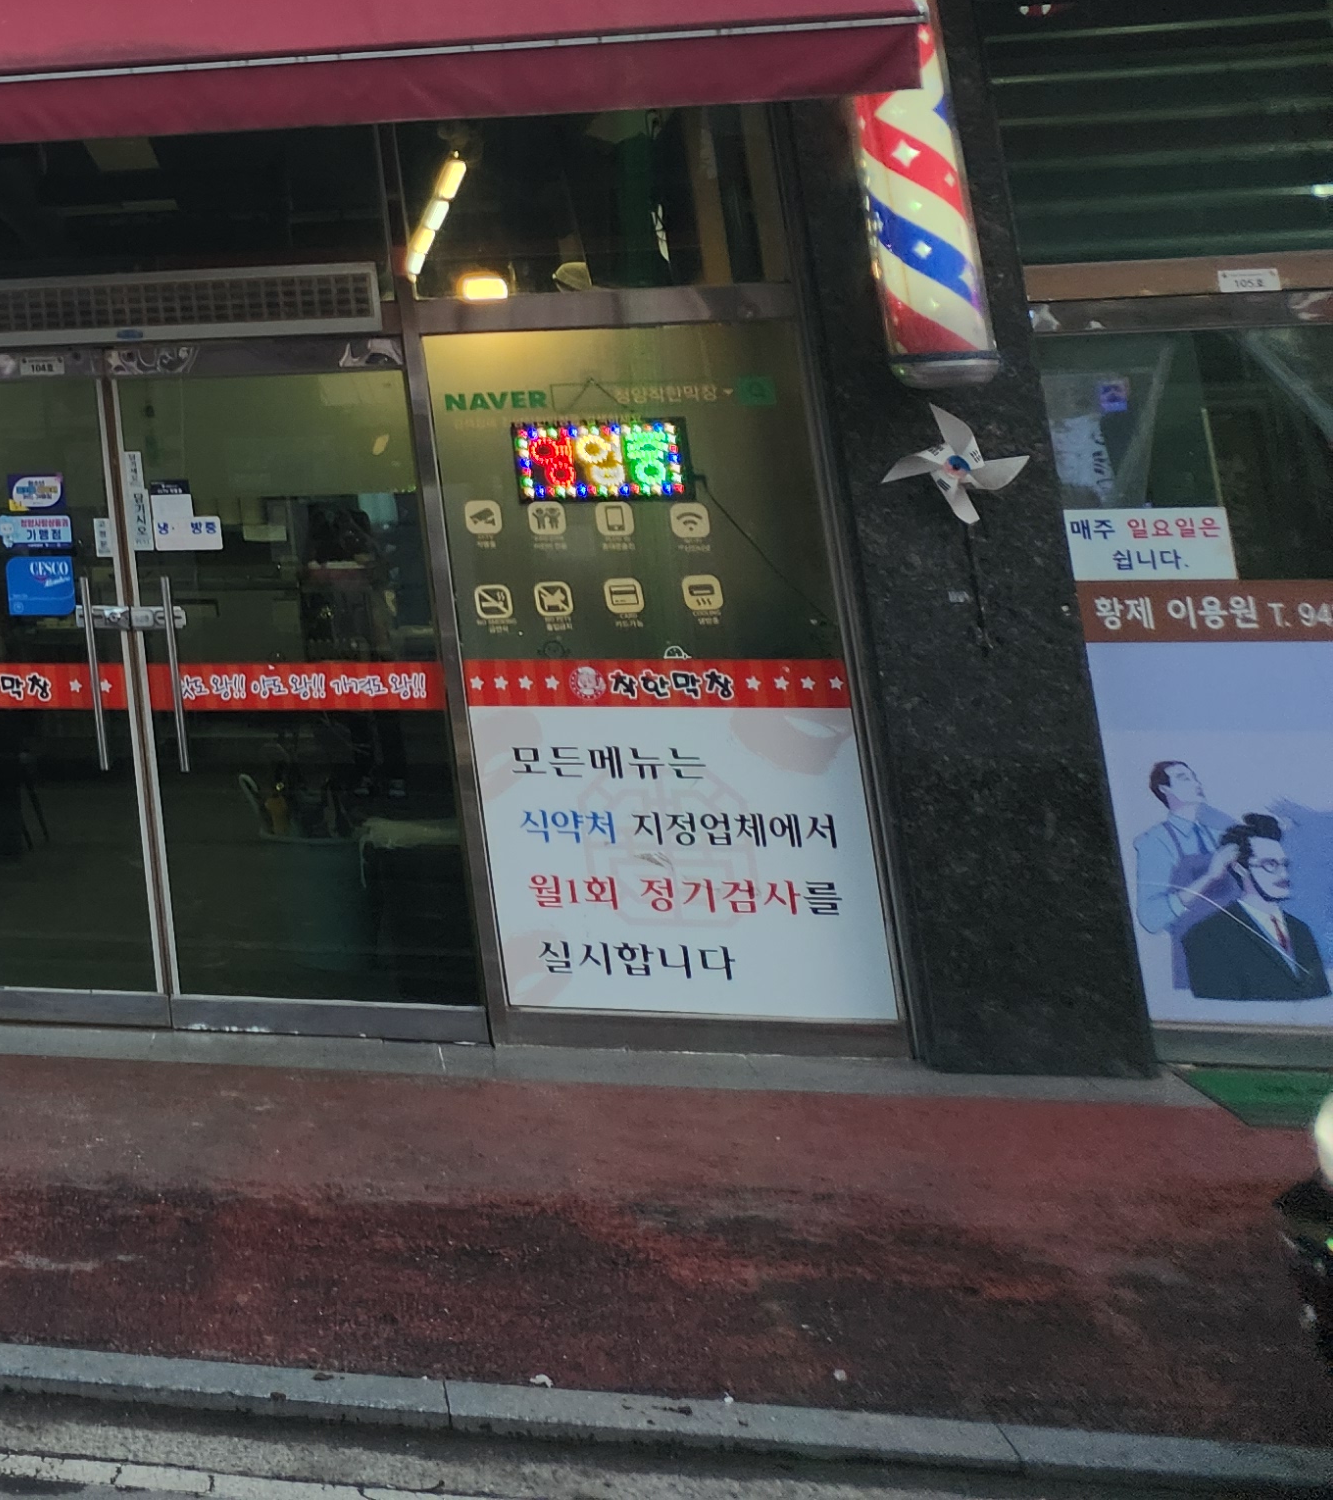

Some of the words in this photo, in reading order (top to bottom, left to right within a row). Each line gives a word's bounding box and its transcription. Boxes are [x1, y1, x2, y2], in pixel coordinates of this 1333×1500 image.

[445, 389, 548, 412] NAVER
[1070, 518, 1116, 539] 매주
[1127, 517, 1222, 538] 일요일은
[30, 561, 69, 576] CESCO
[1112, 548, 1189, 571] 쉽니다.
[1094, 596, 1155, 631] 황제
[1167, 595, 1260, 630] 이용원
[1267, 602, 1292, 627] T.
[1297, 602, 1333, 628] 94
[210, 673, 246, 700] 왕!!
[251, 673, 288, 698] 양도
[289, 673, 325, 699] 왕!!
[330, 674, 388, 697] 가격도
[389, 672, 427, 699] 왕!!
[609, 669, 735, 700] 착한막창
[511, 746, 707, 780] 모든메뉴는
[519, 808, 616, 845] 식약처
[632, 812, 838, 850] 지정업체에서
[528, 873, 619, 912] 월1회
[639, 876, 843, 917] 정기검사를
[537, 940, 736, 981] 실시합니다
